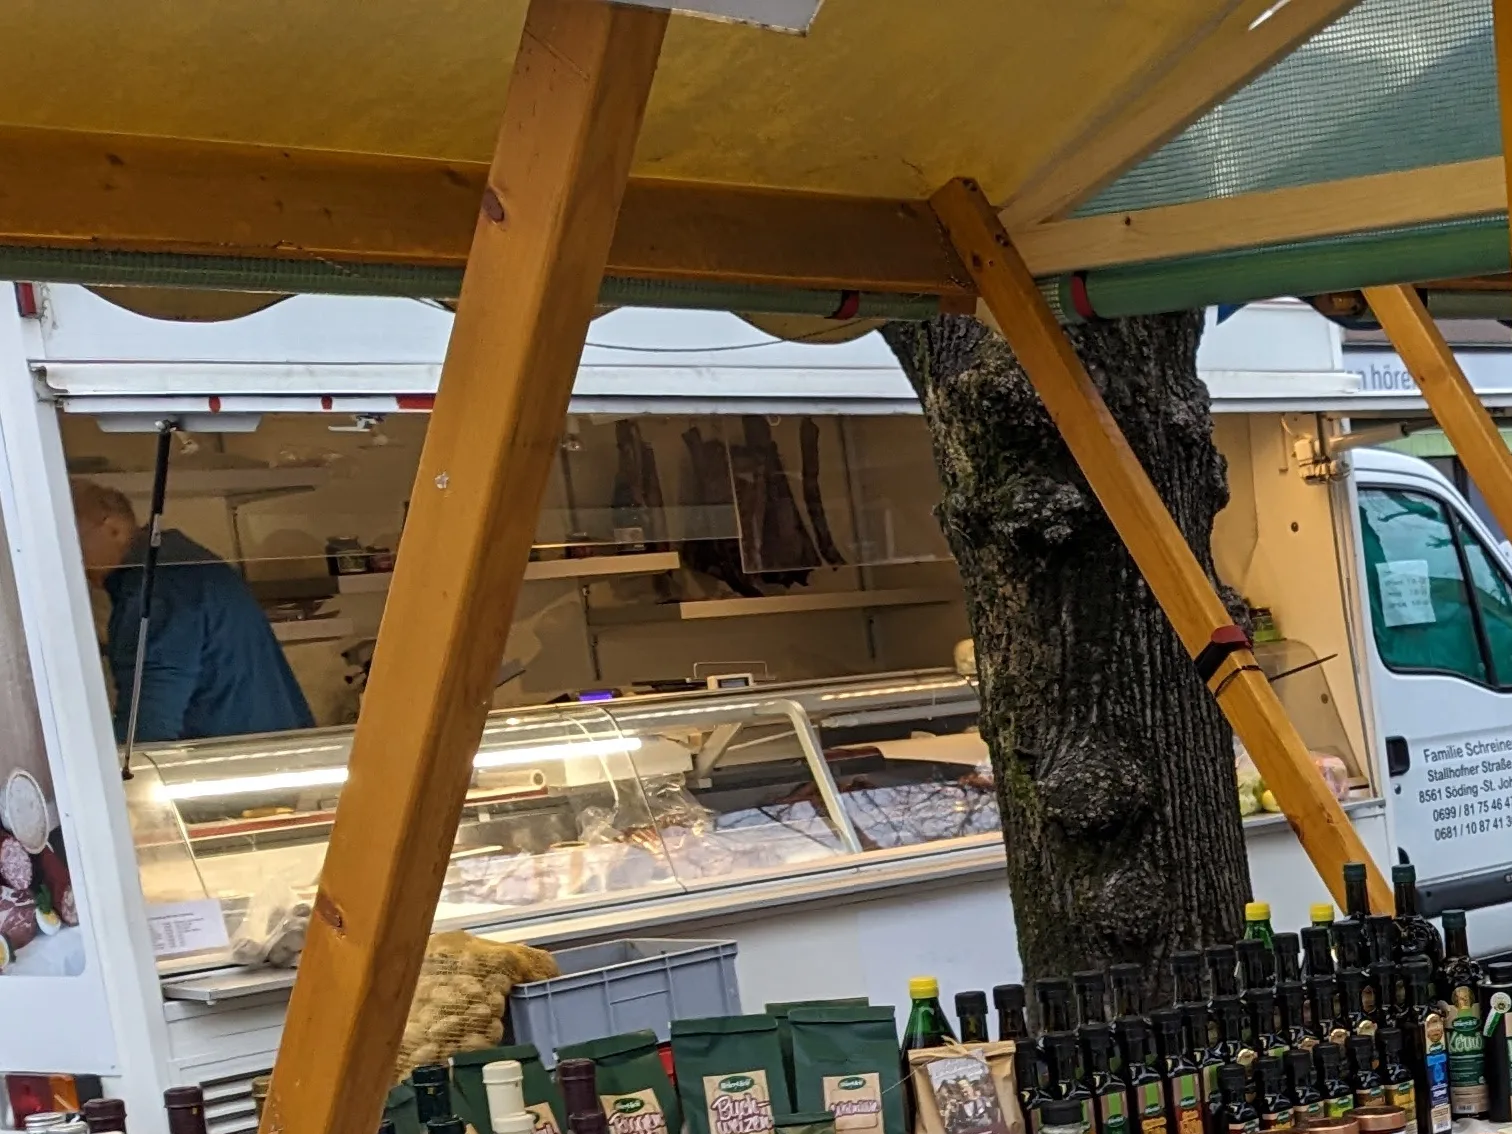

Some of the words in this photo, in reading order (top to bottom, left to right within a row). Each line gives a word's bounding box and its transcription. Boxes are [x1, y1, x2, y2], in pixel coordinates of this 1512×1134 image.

[1371, 364, 1410, 390] höre
[1423, 745, 1464, 763] Familie
[1427, 763, 1480, 783] Stallhofner
[1482, 758, 1512, 774] Straße
[1419, 788, 1443, 804] 8561
[1433, 805, 1457, 823] 0699
[1464, 803, 1475, 816] 81
[1478, 800, 1489, 814] 75
[1491, 798, 1503, 812] 46
[1435, 825, 1458, 841] 0681
[1466, 822, 1477, 835] 10
[1479, 819, 1491, 833] 87
[1493, 817, 1504, 831] 41
[1448, 1030, 1483, 1052] Kernö
